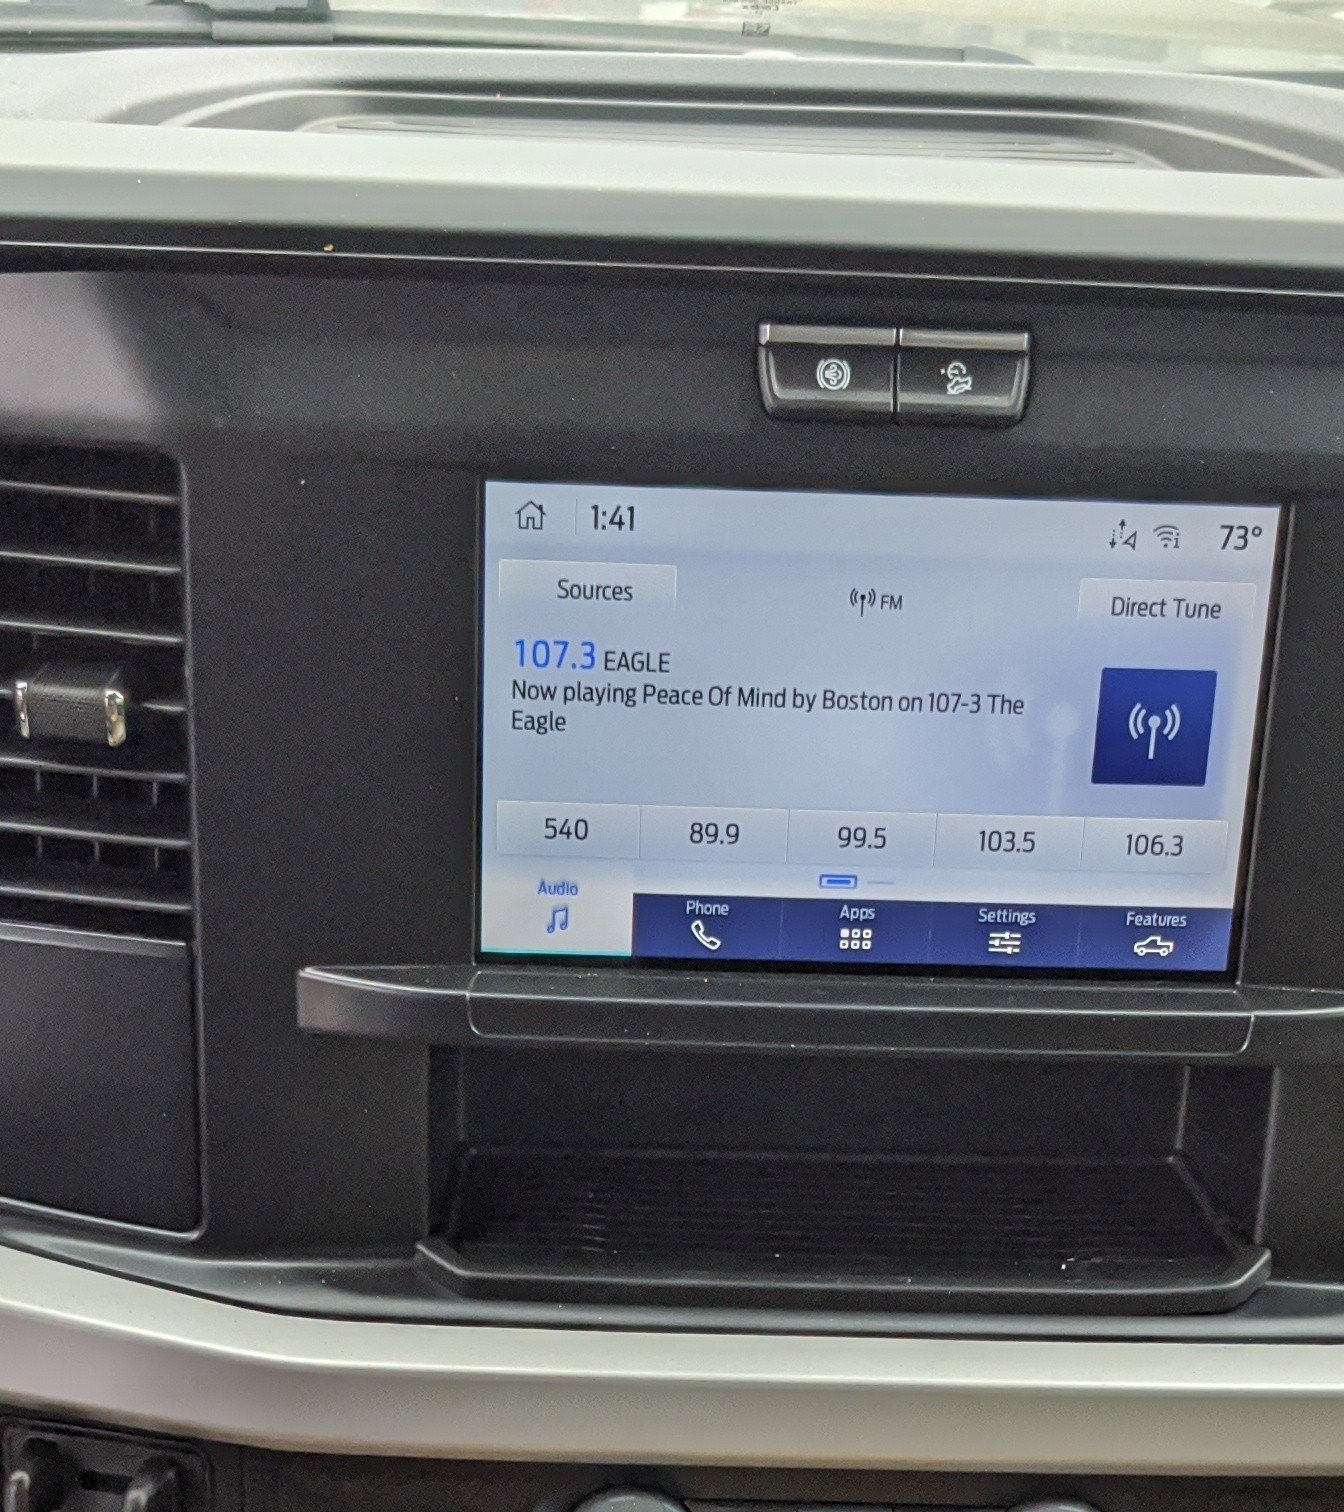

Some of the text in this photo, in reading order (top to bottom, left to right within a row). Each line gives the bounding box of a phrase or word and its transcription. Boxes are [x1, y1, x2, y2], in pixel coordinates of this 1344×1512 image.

[590, 504, 636, 531] 1:41
[1220, 522, 1263, 553] 73°
[556, 577, 634, 602] Sources
[880, 594, 904, 611] FM
[1110, 595, 1222, 621] Direct Tune
[513, 637, 671, 675] 107.3 EAGLE
[511, 680, 1025, 716] Now playing Peace Of Mind by Boston on 107-3 The
[511, 709, 567, 736] Eagle
[544, 817, 589, 842] 540
[688, 821, 741, 846] 89.9
[837, 825, 888, 850] 99.5
[977, 829, 1036, 854] 103.5
[1124, 833, 1185, 858] 106.3
[537, 879, 579, 898] Audio
[685, 899, 730, 919] Phone
[839, 903, 876, 925] Apps
[977, 906, 1036, 928] Settings
[1125, 911, 1188, 930] Features
